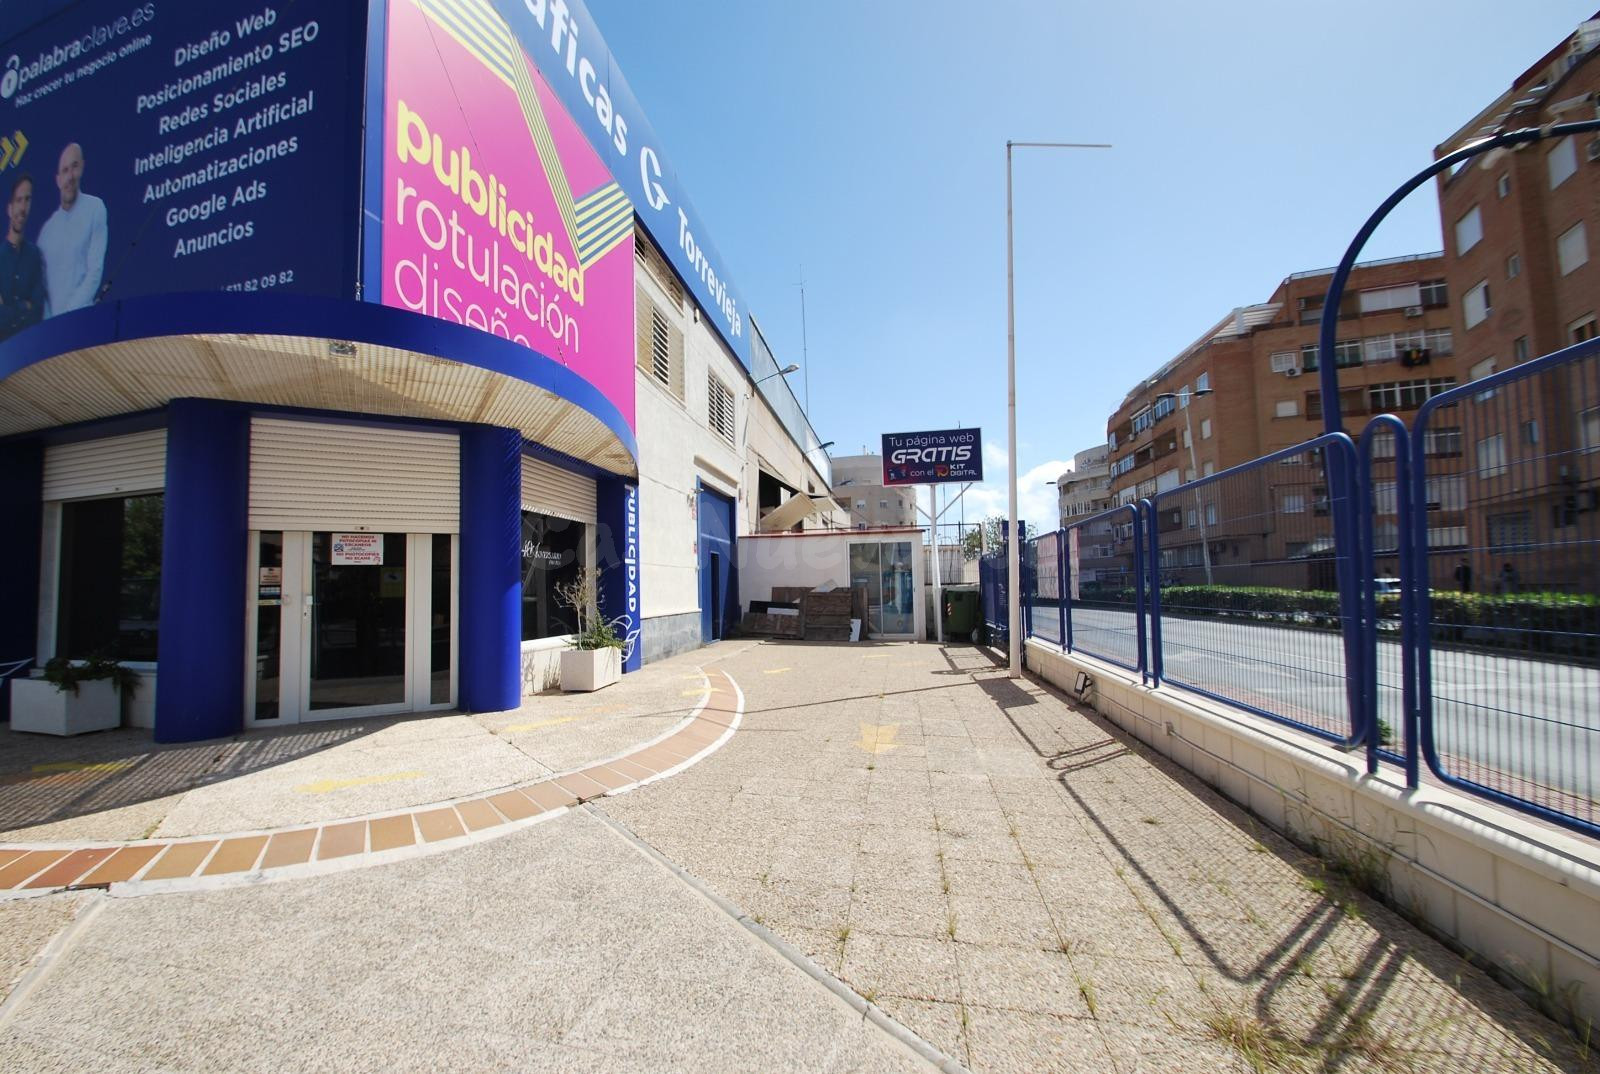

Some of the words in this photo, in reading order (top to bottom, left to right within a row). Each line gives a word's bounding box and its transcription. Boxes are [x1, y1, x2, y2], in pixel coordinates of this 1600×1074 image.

[14, 92, 33, 108] Haz
[32, 77, 63, 100] crecer
[64, 70, 76, 84] tu
[76, 52, 118, 81] negocio
[118, 33, 153, 57] online
[17, 1, 157, 89] palabraclave.es
[135, 45, 274, 114] Posicionamiento
[278, 20, 320, 54] SEO
[173, 27, 231, 68] Diseño
[235, 6, 278, 39] Web
[133, 125, 229, 176] Inteligencia
[233, 90, 315, 139] Artificial
[158, 101, 209, 136] Redes
[212, 70, 287, 114] Sociales
[142, 135, 299, 204] Automatizaciones
[397, 99, 586, 307] publicidad
[165, 191, 227, 228] Google
[231, 180, 268, 205] Ads
[172, 219, 255, 259] Anuncios
[397, 176, 580, 353] rotulación
[677, 207, 742, 338] Torrevieja
[244, 279, 258, 291] 82
[260, 274, 276, 288] 09
[279, 270, 294, 284] 82
[889, 437, 903, 447] Tu
[906, 434, 946, 448] página
[949, 433, 975, 444] web
[891, 445, 973, 464] GRATIS
[910, 469, 926, 477] con
[927, 468, 935, 476] el
[950, 469, 977, 477] DIGITAL
[624, 484, 637, 613] PUBLICIDAD
